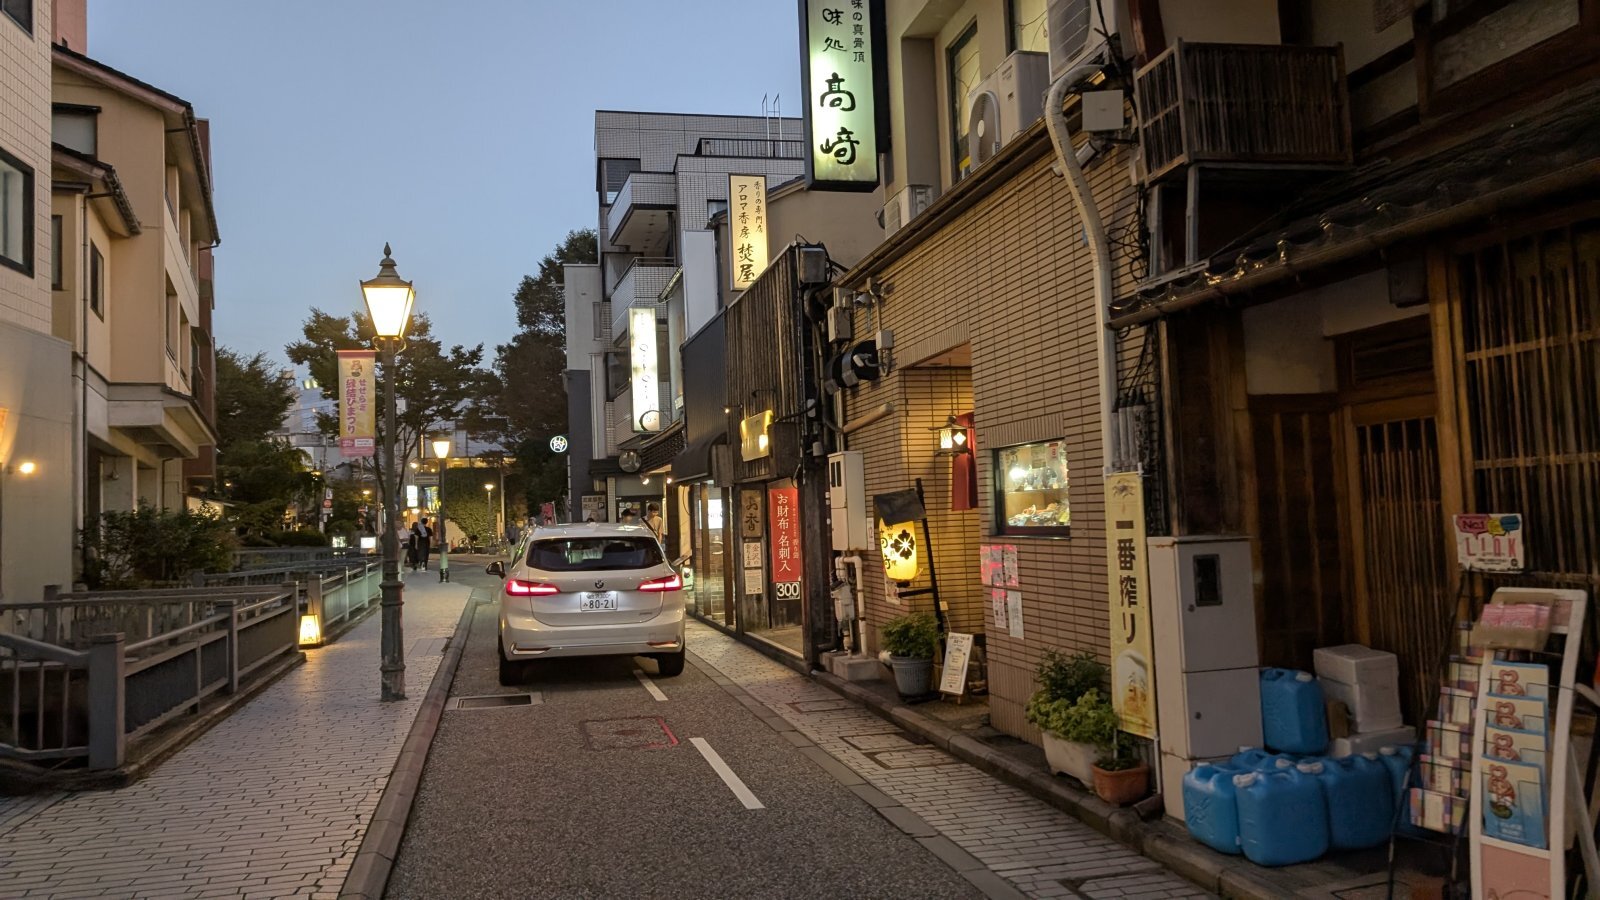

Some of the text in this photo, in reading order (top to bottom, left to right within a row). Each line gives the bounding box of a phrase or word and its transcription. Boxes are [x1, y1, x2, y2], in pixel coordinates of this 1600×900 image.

[822, 8, 848, 52] 味処
[738, 184, 750, 239] アロマ香房
[589, 599, 614, 608] 80-21
[777, 583, 799, 597] 300
[1116, 520, 1137, 644] 一番搾り
